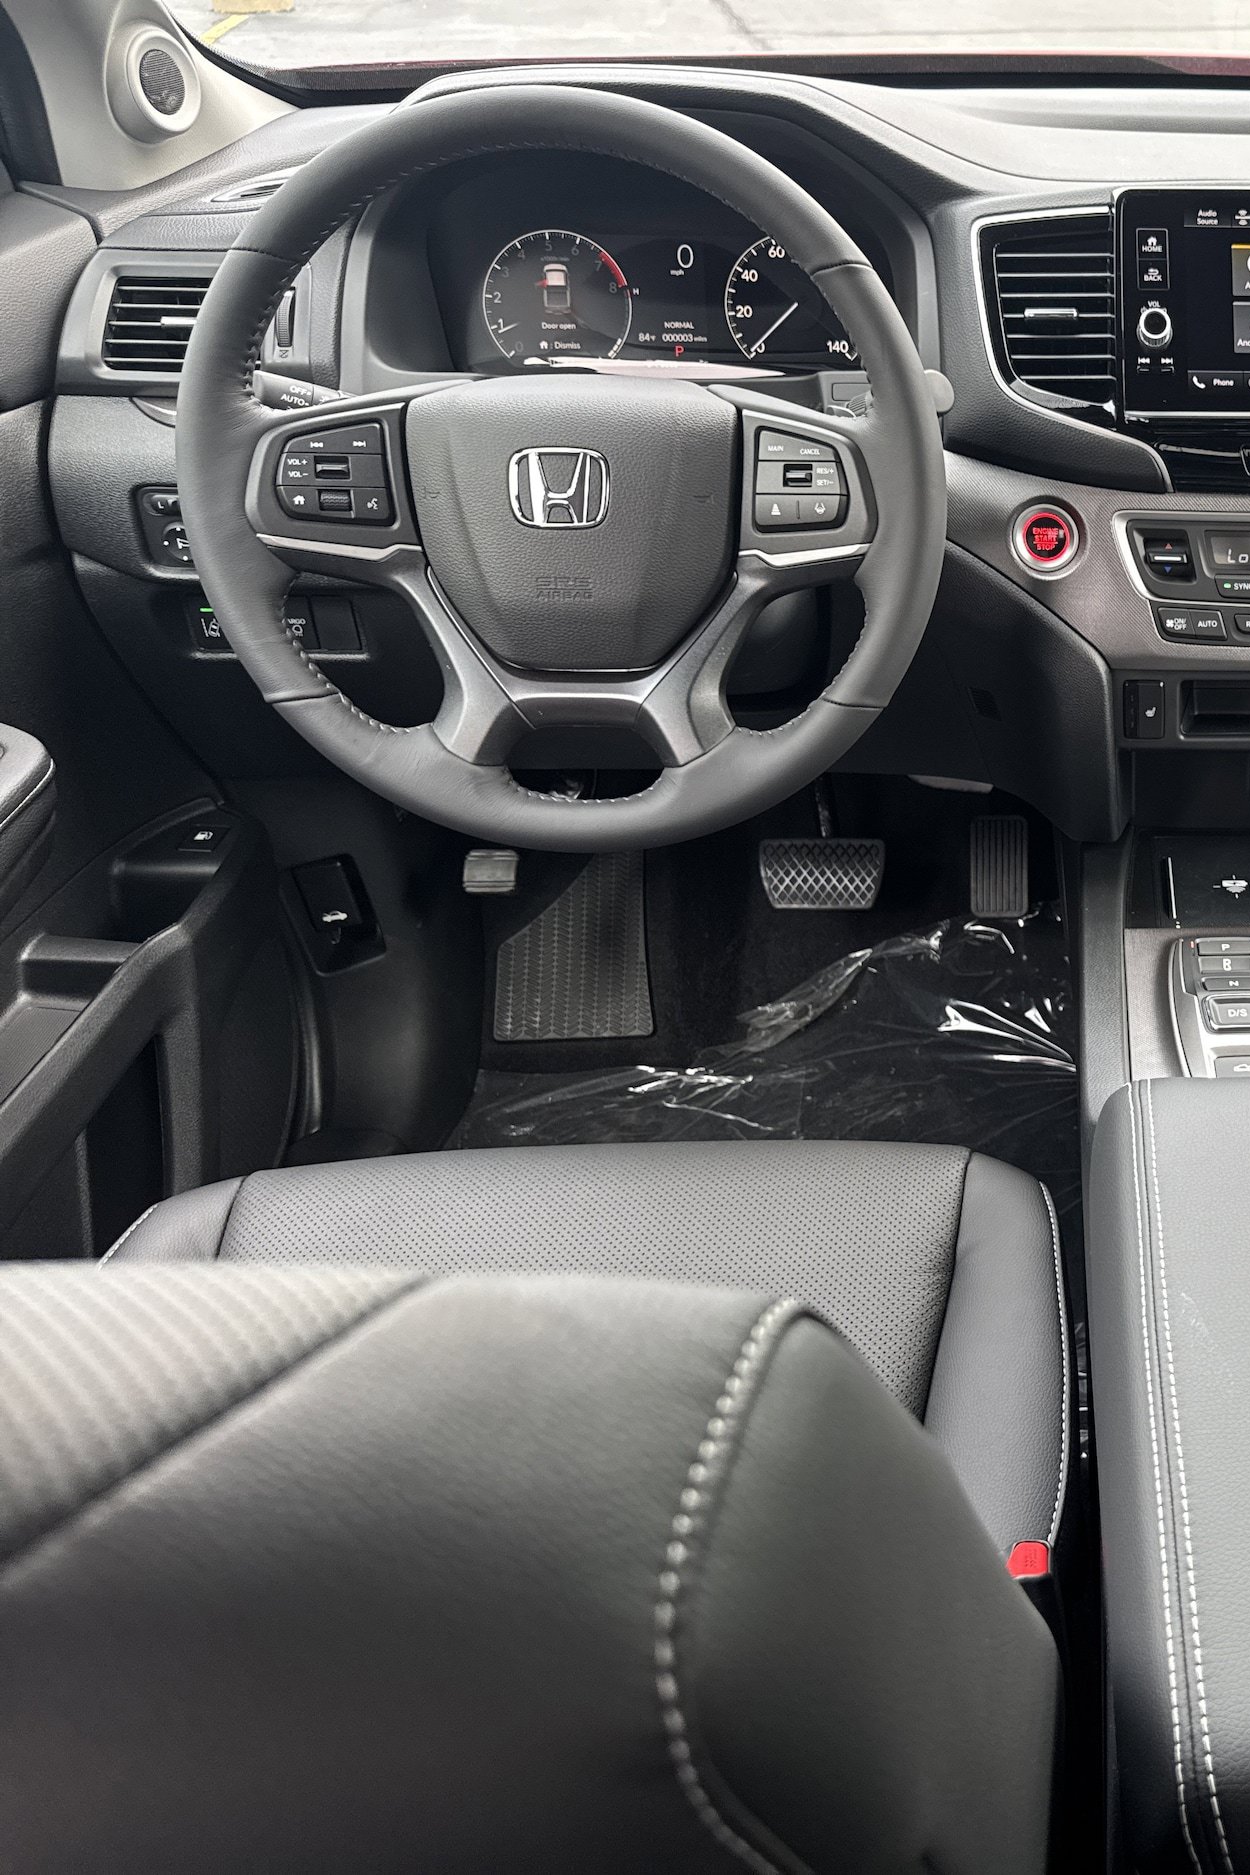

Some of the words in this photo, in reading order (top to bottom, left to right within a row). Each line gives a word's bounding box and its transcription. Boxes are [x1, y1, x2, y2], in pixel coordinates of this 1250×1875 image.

[1198, 209, 1217, 218] Audio
[1197, 218, 1219, 226] Source
[768, 246, 785, 259] 60
[1141, 245, 1163, 253] HOME
[677, 244, 694, 269] 0
[670, 269, 684, 277] mph
[741, 270, 758, 282] 40
[1143, 274, 1163, 282] BACK
[609, 282, 617, 293] 8
[493, 292, 502, 303] 2
[1147, 300, 1161, 308] VOL
[735, 305, 753, 318] 20
[541, 322, 558, 330] Door
[559, 323, 576, 331] open
[664, 321, 695, 330] NORMAL
[554, 341, 581, 350] Dismiss
[827, 341, 849, 353] 140
[675, 345, 685, 357] P
[1213, 378, 1234, 387] Phone
[290, 385, 307, 396] OFF
[281, 394, 305, 406] AUTO
[1032, 527, 1059, 535] ENGINE
[1036, 543, 1056, 551] STOP
[1198, 620, 1218, 628] AUTO
[1221, 943, 1230, 951] P
[1227, 1008, 1248, 1018] D/S
